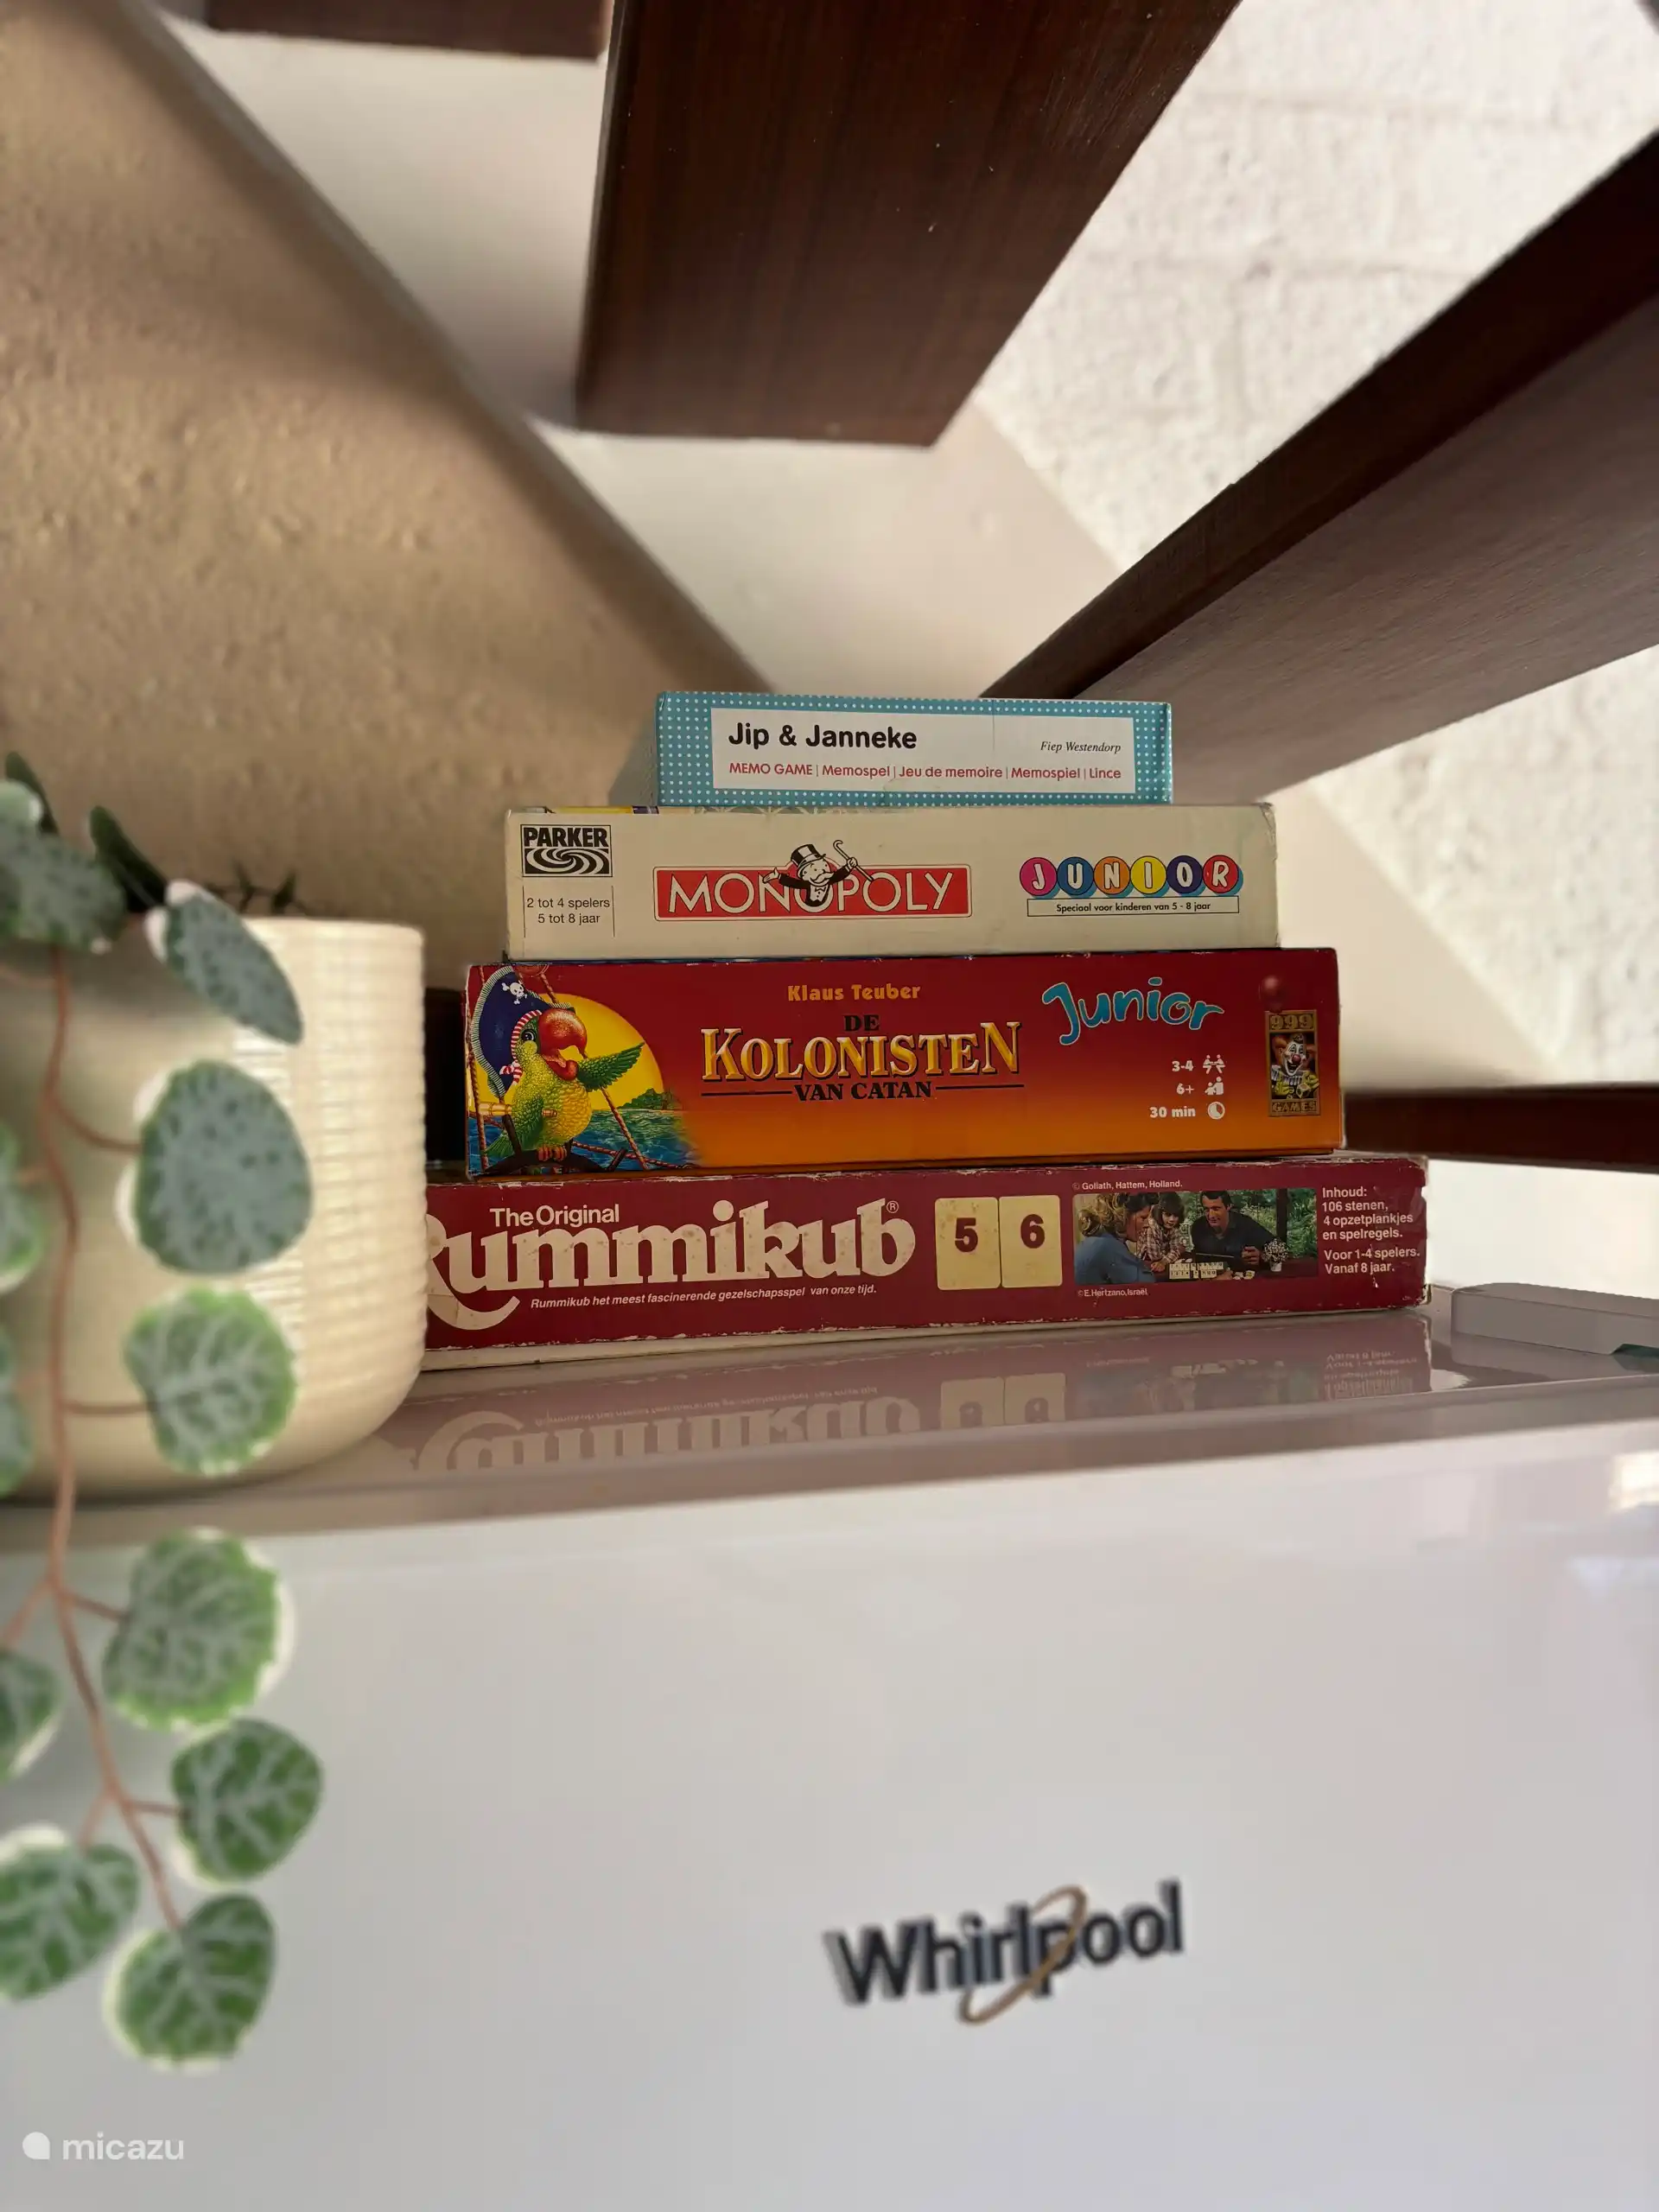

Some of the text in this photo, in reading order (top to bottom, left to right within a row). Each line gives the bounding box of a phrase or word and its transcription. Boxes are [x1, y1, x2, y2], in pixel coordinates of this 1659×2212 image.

[728, 722, 917, 750] Jip & Janneke
[1040, 741, 1122, 754] Fiep Westendorp
[729, 762, 1122, 781] MEMO GAME Memospel Jeu de memoire Memospiel Lince
[523, 827, 609, 848] PARKER
[1032, 861, 1228, 890] JUNIOR
[526, 898, 610, 910] 2 tot 4 spelers
[1056, 904, 1091, 914] Speciaal
[1115, 902, 1152, 912] kinderen
[1185, 901, 1192, 910] 8
[1193, 901, 1211, 912] jaar
[537, 913, 601, 925] 5 tot 8 jaar
[787, 983, 921, 1001] Klaus Teuber
[1041, 976, 1225, 1046] Junior
[843, 1014, 880, 1032] DE
[1269, 1014, 1314, 1030] 999
[700, 1020, 1021, 1082] KOLONISTEN
[1171, 1059, 1194, 1072] 3-4
[793, 1081, 933, 1102] VAN CATAN
[1176, 1084, 1194, 1096] 6+
[1149, 1105, 1197, 1119] 30 min
[1271, 1102, 1317, 1113] GAMES
[1082, 1181, 1114, 1190] Goliath,
[1116, 1180, 1147, 1189] Hattem,
[1149, 1179, 1183, 1188] Holland.
[1322, 1186, 1367, 1198] Inhoud:
[1322, 1201, 1389, 1211] 106 stenen,
[489, 1205, 620, 1228] The Original
[1324, 1212, 1414, 1228] 4 opzetplankjes
[954, 1217, 979, 1253] 5
[1020, 1213, 1046, 1249] 6
[1322, 1227, 1403, 1242] en spelregels.
[1324, 1247, 1420, 1261] Voor 1-4 spelers.
[1325, 1262, 1395, 1275] Vanaf 8 jaar.
[531, 1284, 877, 1309] Rummikub het meest fascinerende gezelschapsspel van onze tijd.
[823, 1878, 1183, 2007] Whirlpool
